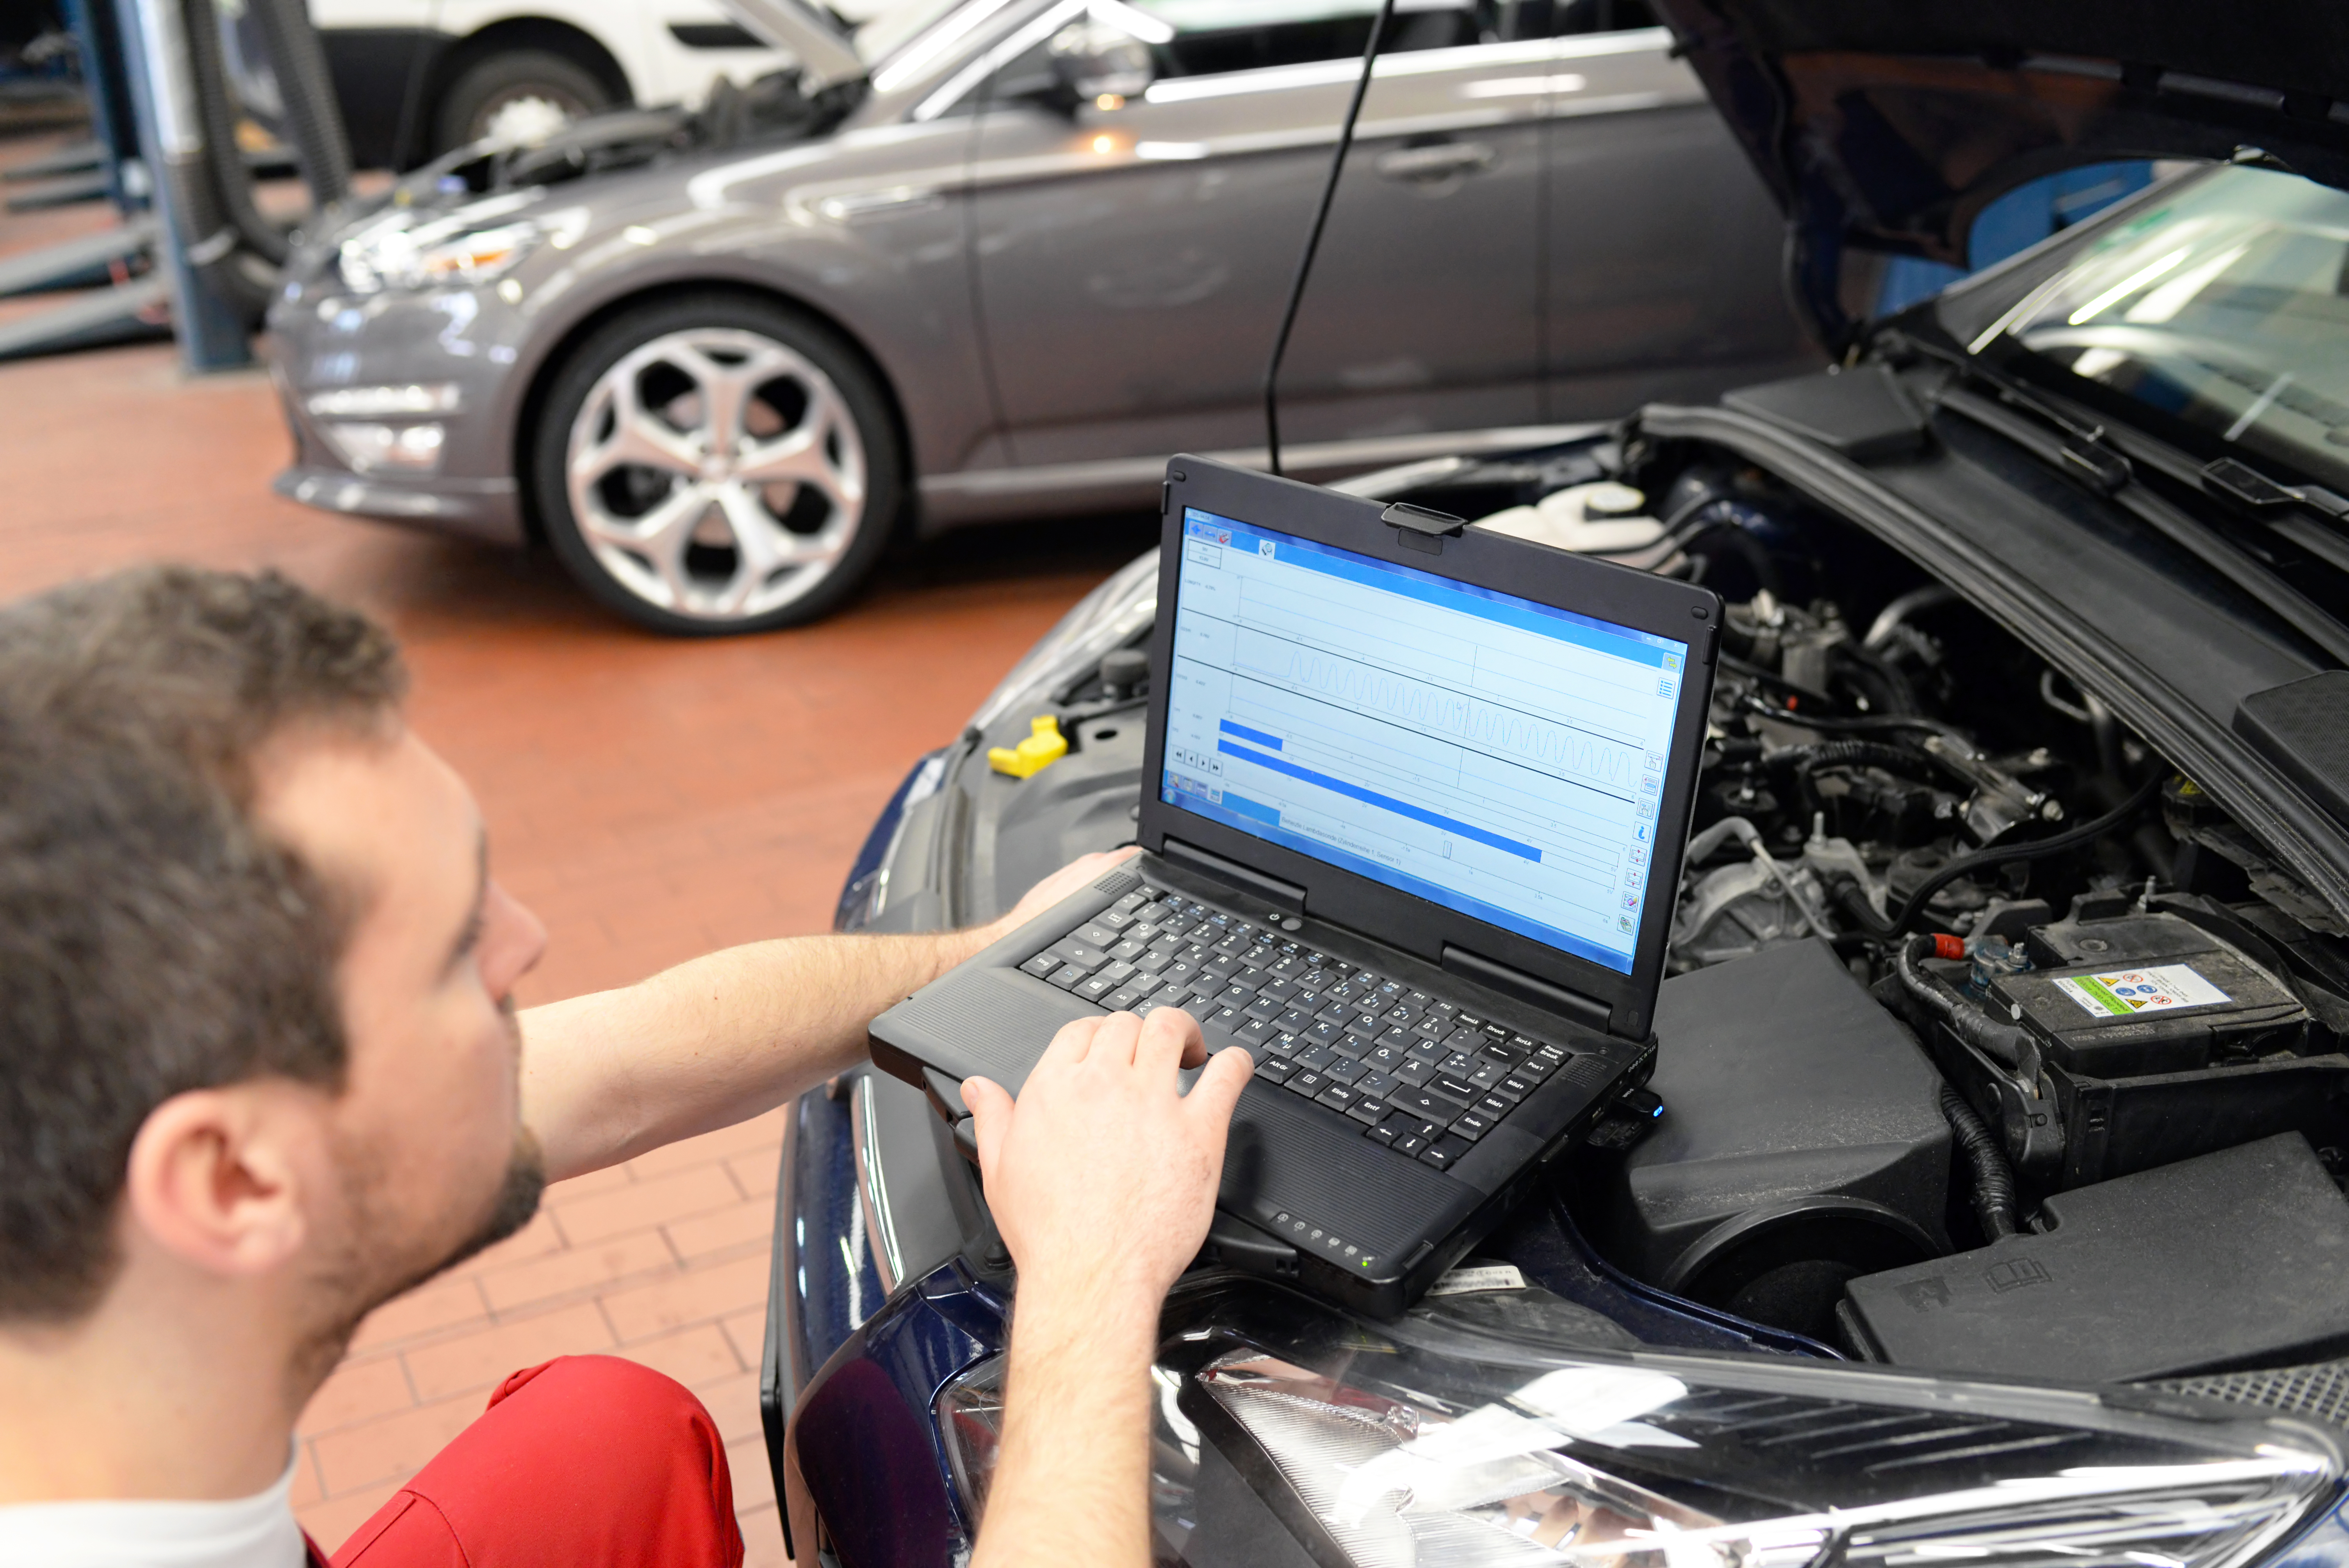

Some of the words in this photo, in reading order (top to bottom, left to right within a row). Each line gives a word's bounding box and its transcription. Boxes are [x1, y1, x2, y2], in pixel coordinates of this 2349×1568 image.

[1281, 817, 1302, 829] Beheizte
[1303, 825, 1337, 841] Lambdasonde
[1338, 837, 1370, 853] (Zylinderreihe
[1377, 852, 1394, 862] Sensor
[1166, 934, 1178, 942] W
[1460, 1014, 1479, 1025] NumLk
[1487, 1025, 1506, 1035] Druck
[1280, 1034, 1294, 1042] M
[1515, 1037, 1532, 1046] ScrLk
[1422, 1041, 1433, 1049] Ü
[1545, 1045, 1563, 1055] Pause
[1378, 1048, 1389, 1057] Ö
[1540, 1049, 1559, 1060] Break
[1407, 1061, 1420, 1071] Ä
[1528, 1062, 1544, 1071] Pos1
[1331, 1088, 1349, 1098] Einfg
[1364, 1102, 1380, 1111] Entf
[1465, 1117, 1481, 1127] Ende
